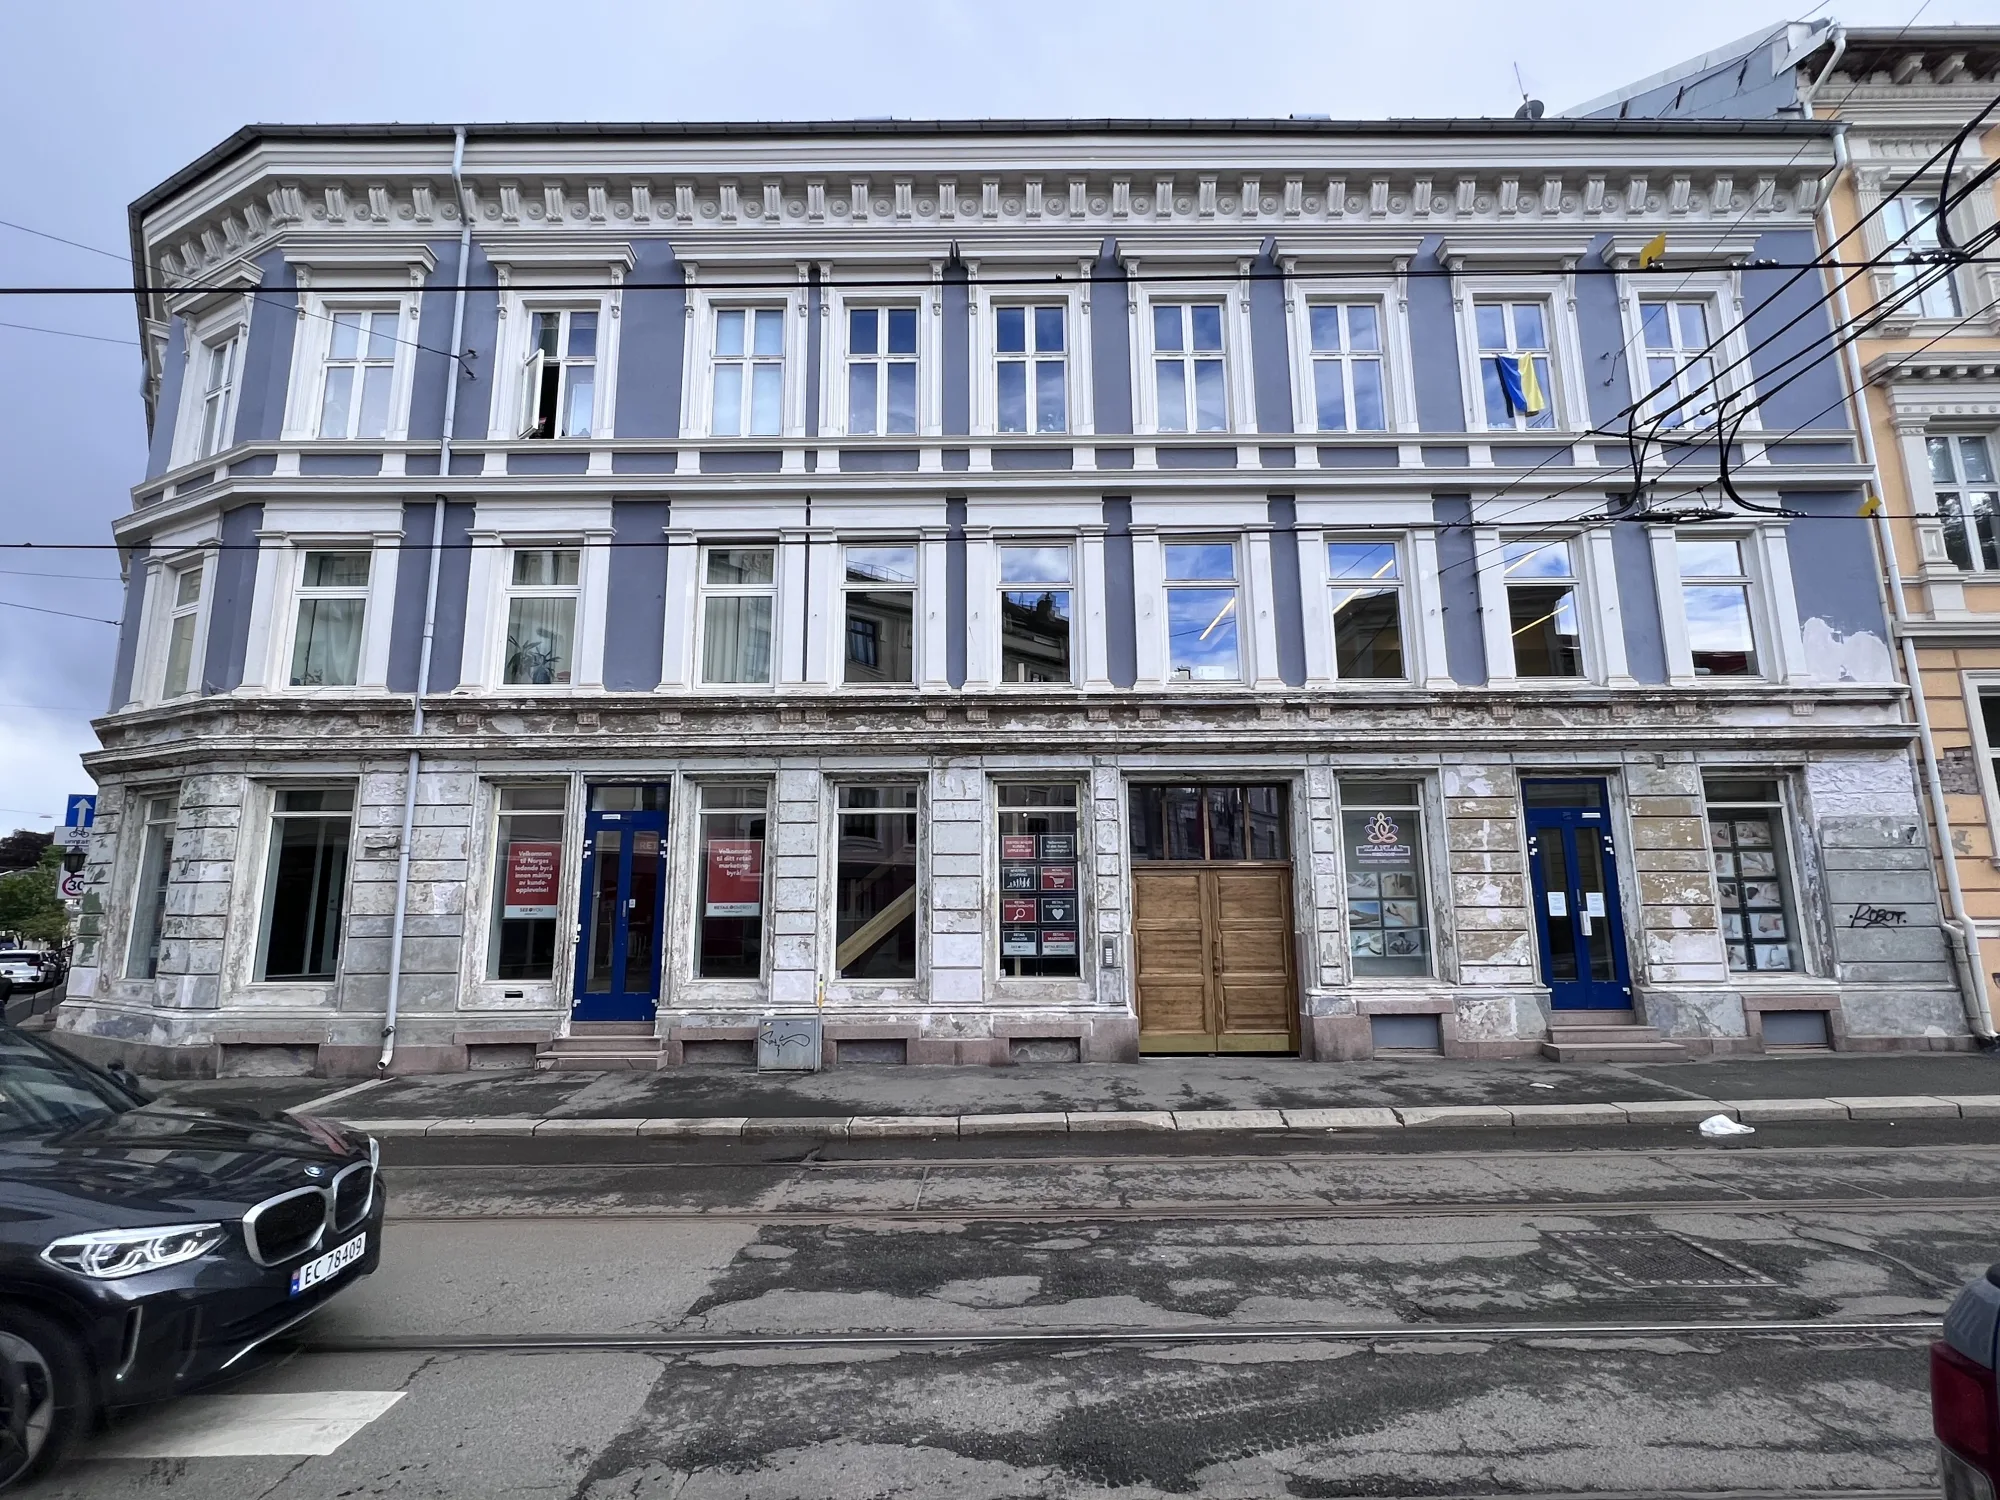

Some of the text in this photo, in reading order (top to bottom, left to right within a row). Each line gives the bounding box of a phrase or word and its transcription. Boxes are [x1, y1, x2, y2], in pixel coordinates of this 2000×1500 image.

[539, 865, 553, 873] byrå
[532, 872, 552, 880] måling
[67, 880, 84, 891] 30
[305, 1237, 362, 1286] EC 78409
